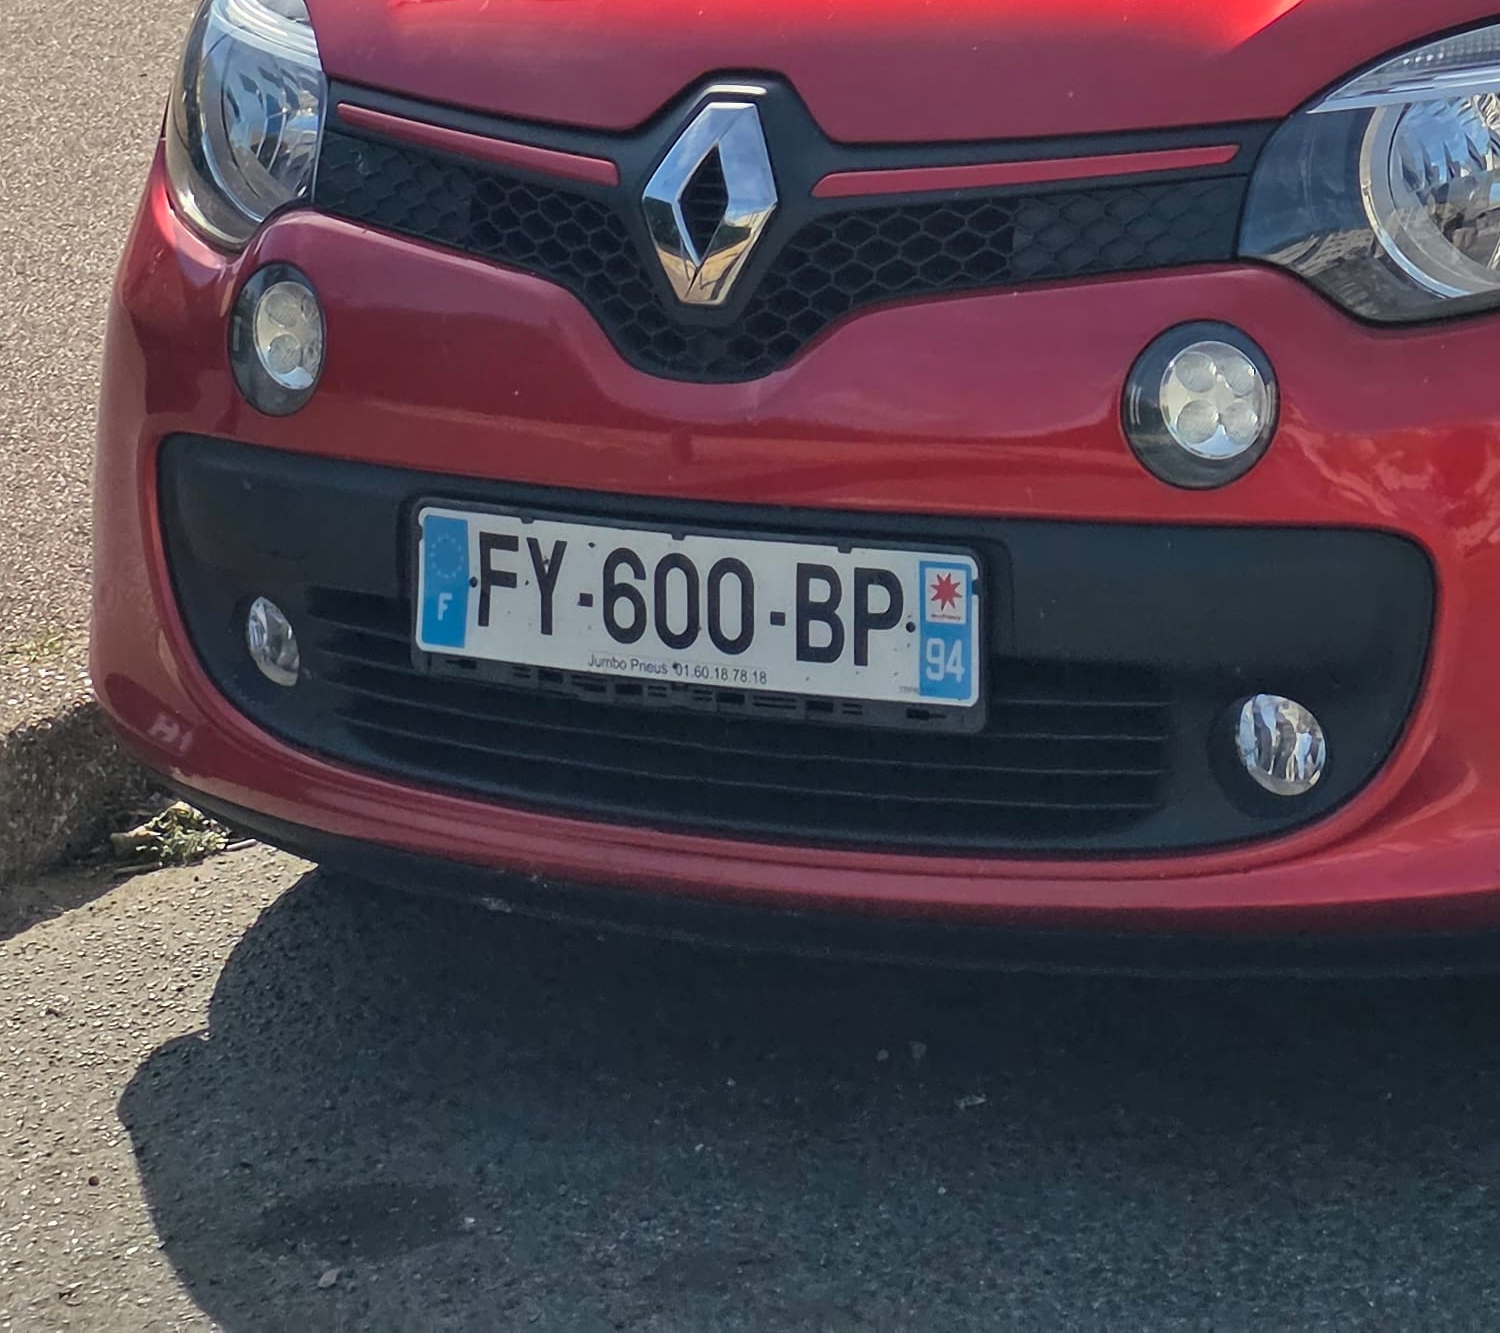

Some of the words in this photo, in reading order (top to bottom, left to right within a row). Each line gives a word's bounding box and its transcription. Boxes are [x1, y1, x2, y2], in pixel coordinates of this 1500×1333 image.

[436, 591, 453, 622] F
[477, 530, 904, 667] FY-600-BP
[587, 653, 627, 671] Jumbo
[630, 658, 668, 675] Pneus
[926, 637, 965, 683] 94
